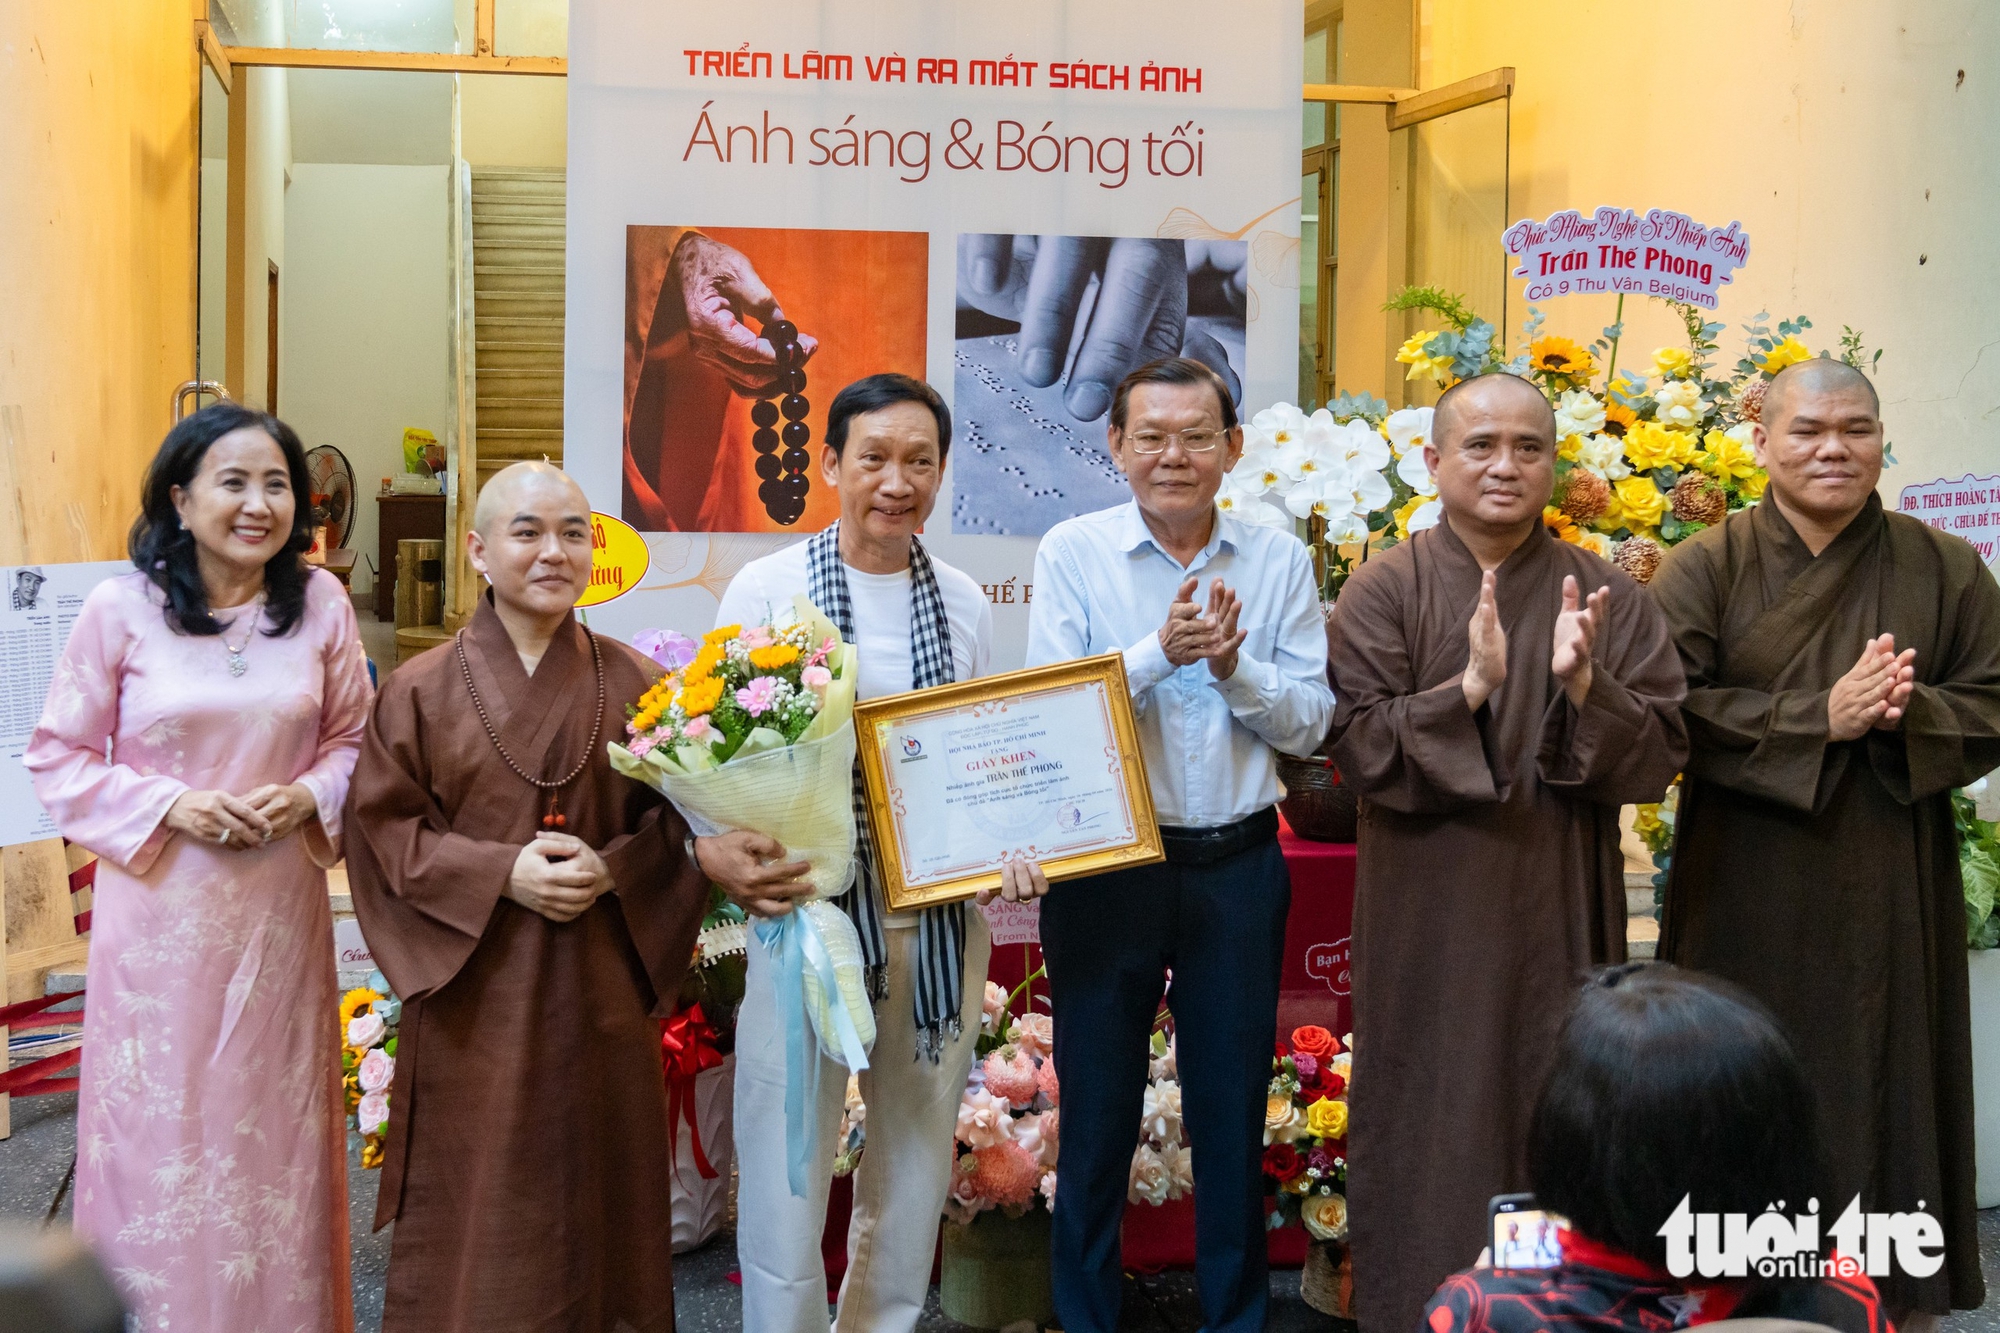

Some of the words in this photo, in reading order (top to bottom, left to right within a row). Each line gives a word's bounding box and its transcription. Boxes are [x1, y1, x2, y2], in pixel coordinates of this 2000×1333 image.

[683, 42, 772, 78] TRIỂN
[784, 50, 853, 81] LÃM
[864, 51, 906, 83] VÀ
[917, 59, 958, 85] RA
[969, 53, 1038, 87] MẮT
[1049, 58, 1129, 91] SÁCH
[1140, 61, 1202, 93] ẢNH
[682, 100, 793, 164] Ánh
[808, 114, 931, 183] sáng
[944, 118, 984, 170] &
[996, 120, 1130, 189] Bóng
[1142, 120, 1204, 177] tối
[1506, 223, 1547, 253] Chúc
[1550, 214, 1597, 242] Mừng
[1599, 210, 1638, 242] Nghệ
[1640, 211, 1665, 242] Sĩ
[1664, 214, 1707, 251] Nhiếp
[1710, 224, 1747, 265] Ảnh
[1538, 249, 1588, 277] Trần
[1598, 245, 1639, 269] Thế
[1644, 246, 1713, 285] Phong
[1529, 283, 1553, 300] Cô
[1559, 280, 1570, 294] 9
[1575, 278, 1606, 291] Thu
[1612, 277, 1643, 291] Vân
[1649, 279, 1715, 307] Belgium
[1923, 488, 1953, 509] THÍCH
[1954, 510, 1976, 529] CHÙA
[587, 562, 626, 591] ừng
[981, 576, 1017, 604] HẾ
[1023, 584, 1034, 604] P
[1000, 749, 1036, 764] KHEN
[1010, 764, 1028, 778] THẾ
[1029, 759, 1063, 774] PHONG
[988, 902, 1022, 916] SÁNG
[1007, 914, 1037, 929] Công
[996, 933, 1027, 942] From
[1030, 932, 1038, 940] N
[1316, 953, 1341, 968] Bạn
